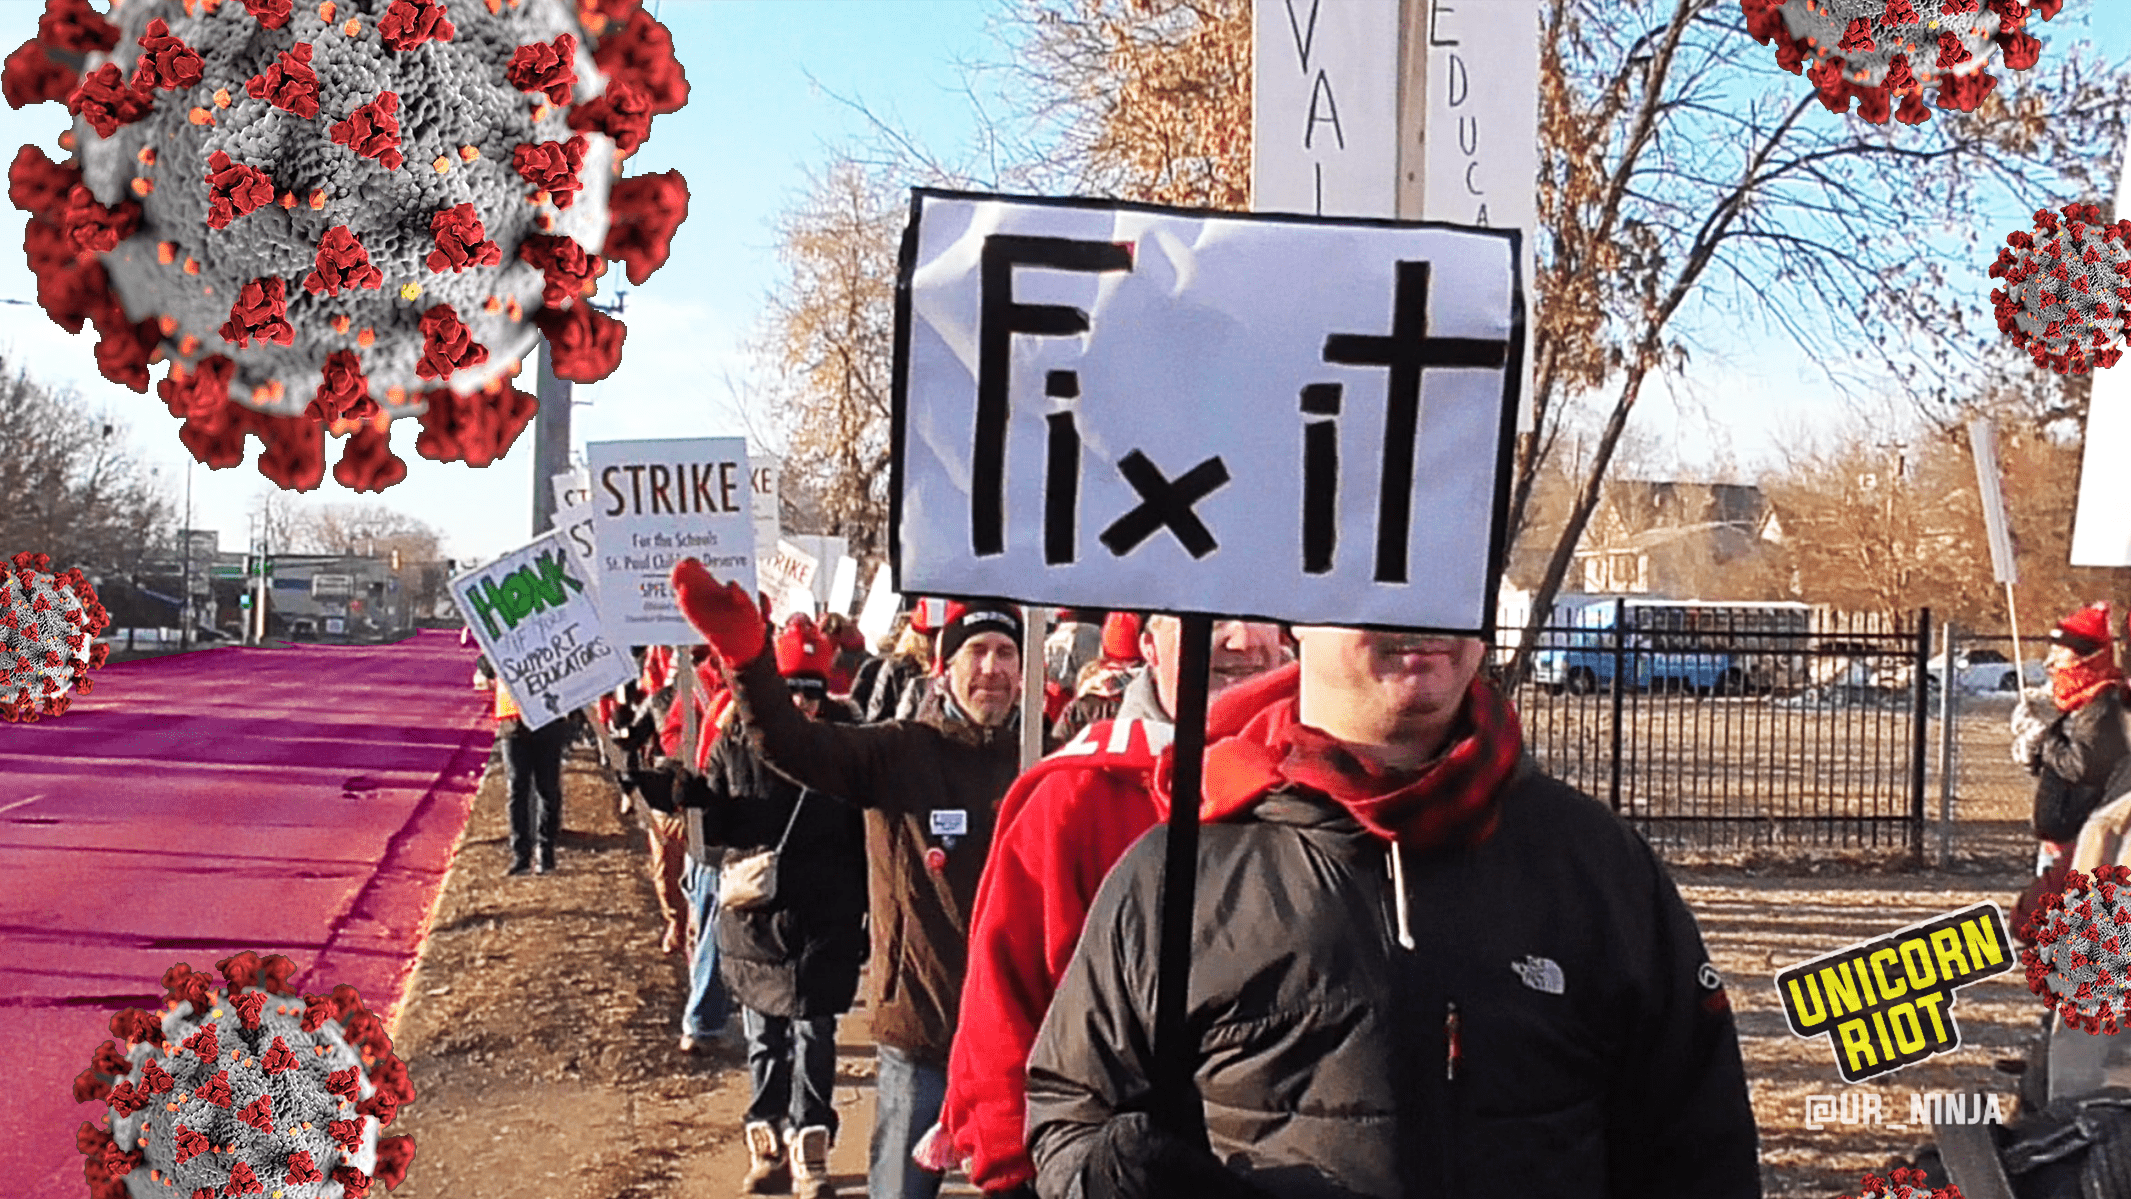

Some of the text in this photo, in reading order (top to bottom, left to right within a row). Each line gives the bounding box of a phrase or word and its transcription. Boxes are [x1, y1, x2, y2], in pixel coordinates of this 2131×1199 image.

[972, 234, 1509, 585] Fix it
[601, 461, 740, 517] STRIKE
[465, 547, 585, 643] HONK
[524, 635, 612, 696] EDUCATORS
